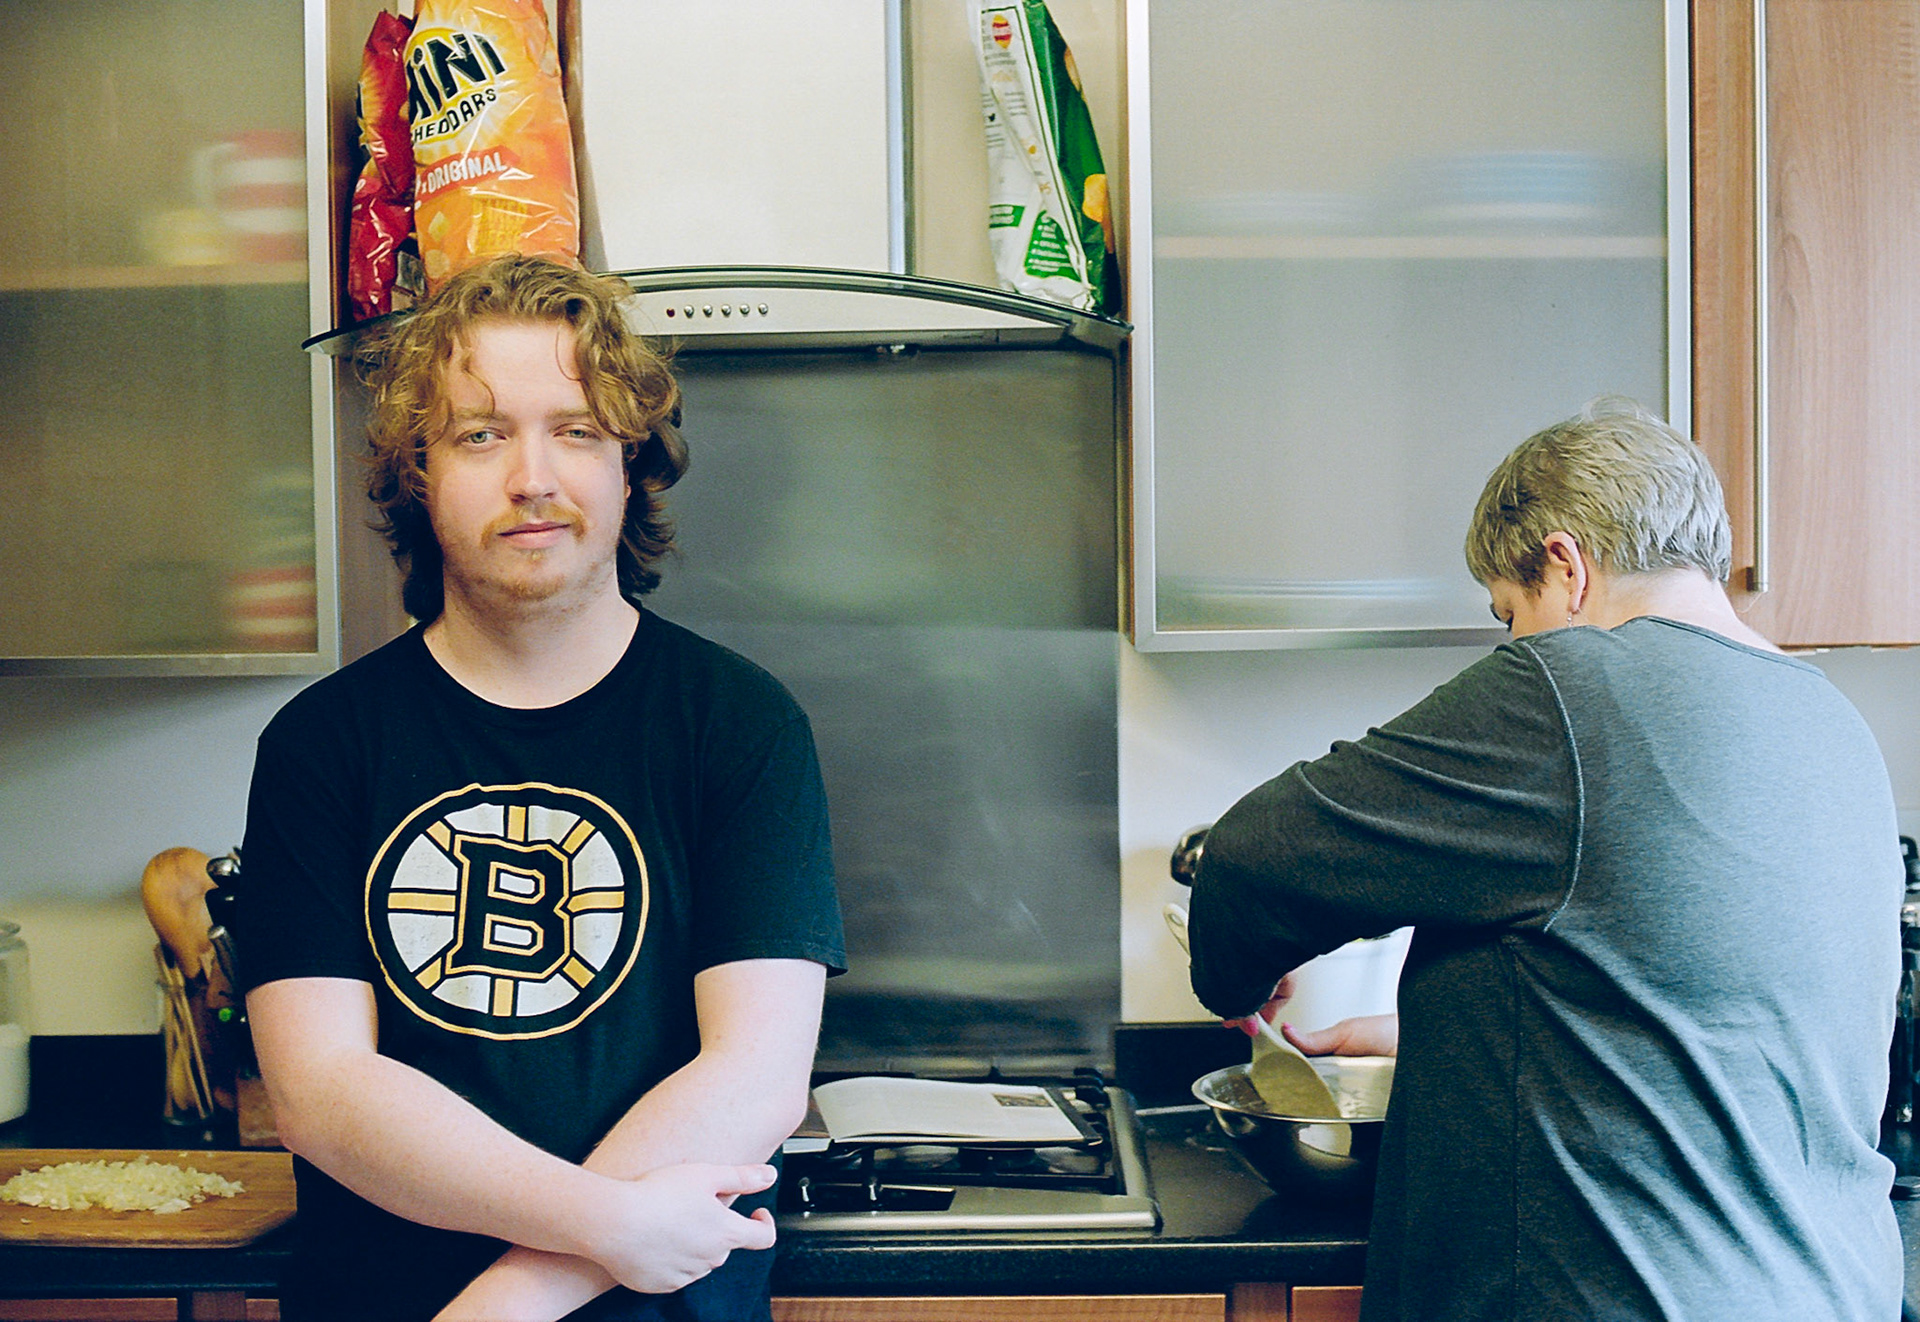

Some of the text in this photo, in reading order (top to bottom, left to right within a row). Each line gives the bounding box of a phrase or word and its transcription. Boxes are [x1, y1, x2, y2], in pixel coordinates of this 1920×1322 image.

[411, 88, 497, 142] HEDDARS
[427, 151, 508, 193] ORIGINAL
[444, 833, 571, 980] B
